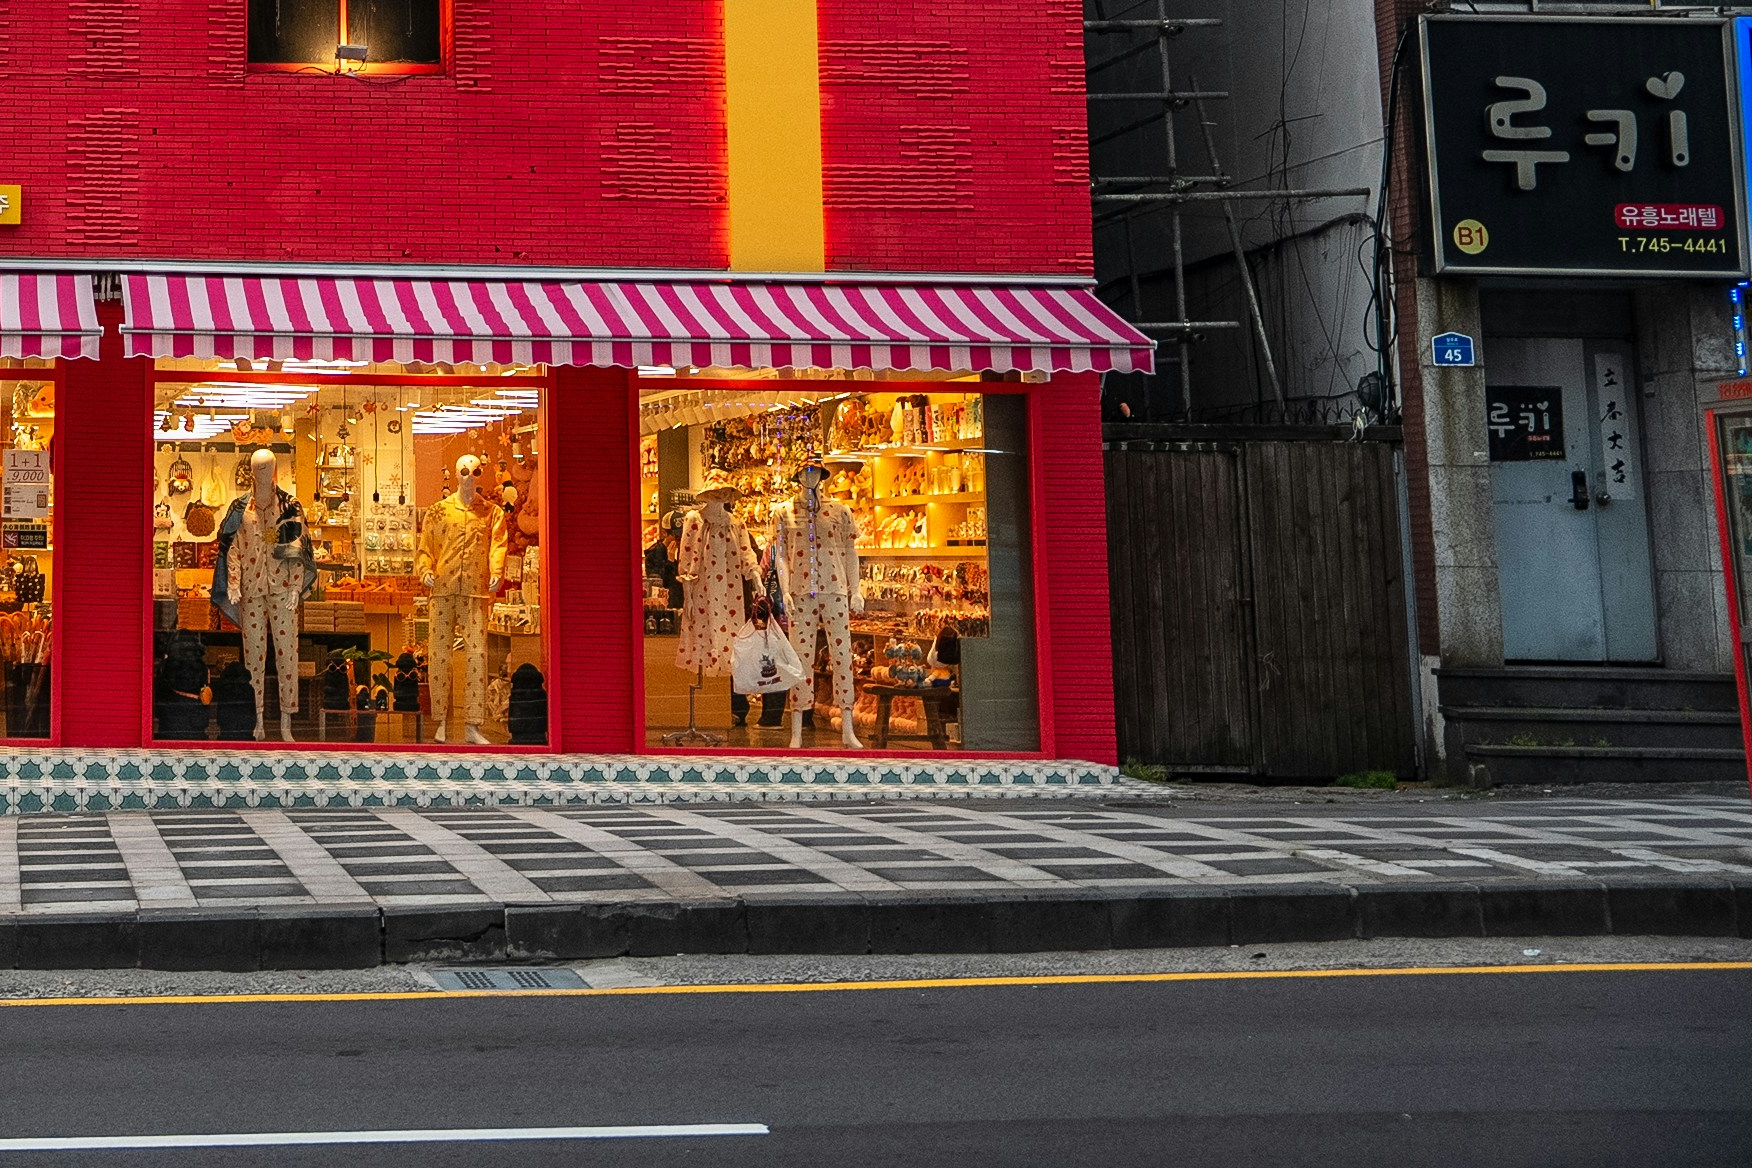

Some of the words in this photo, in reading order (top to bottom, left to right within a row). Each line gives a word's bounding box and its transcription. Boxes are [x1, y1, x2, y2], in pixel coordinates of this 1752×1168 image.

[1482, 71, 1690, 191] 루키
[1620, 205, 1717, 228] 유흥노래텔
[1457, 227, 1485, 246] B1
[1618, 237, 1727, 254] T.745-4441
[1444, 348, 1463, 363] 45
[1488, 400, 1550, 439] 루키
